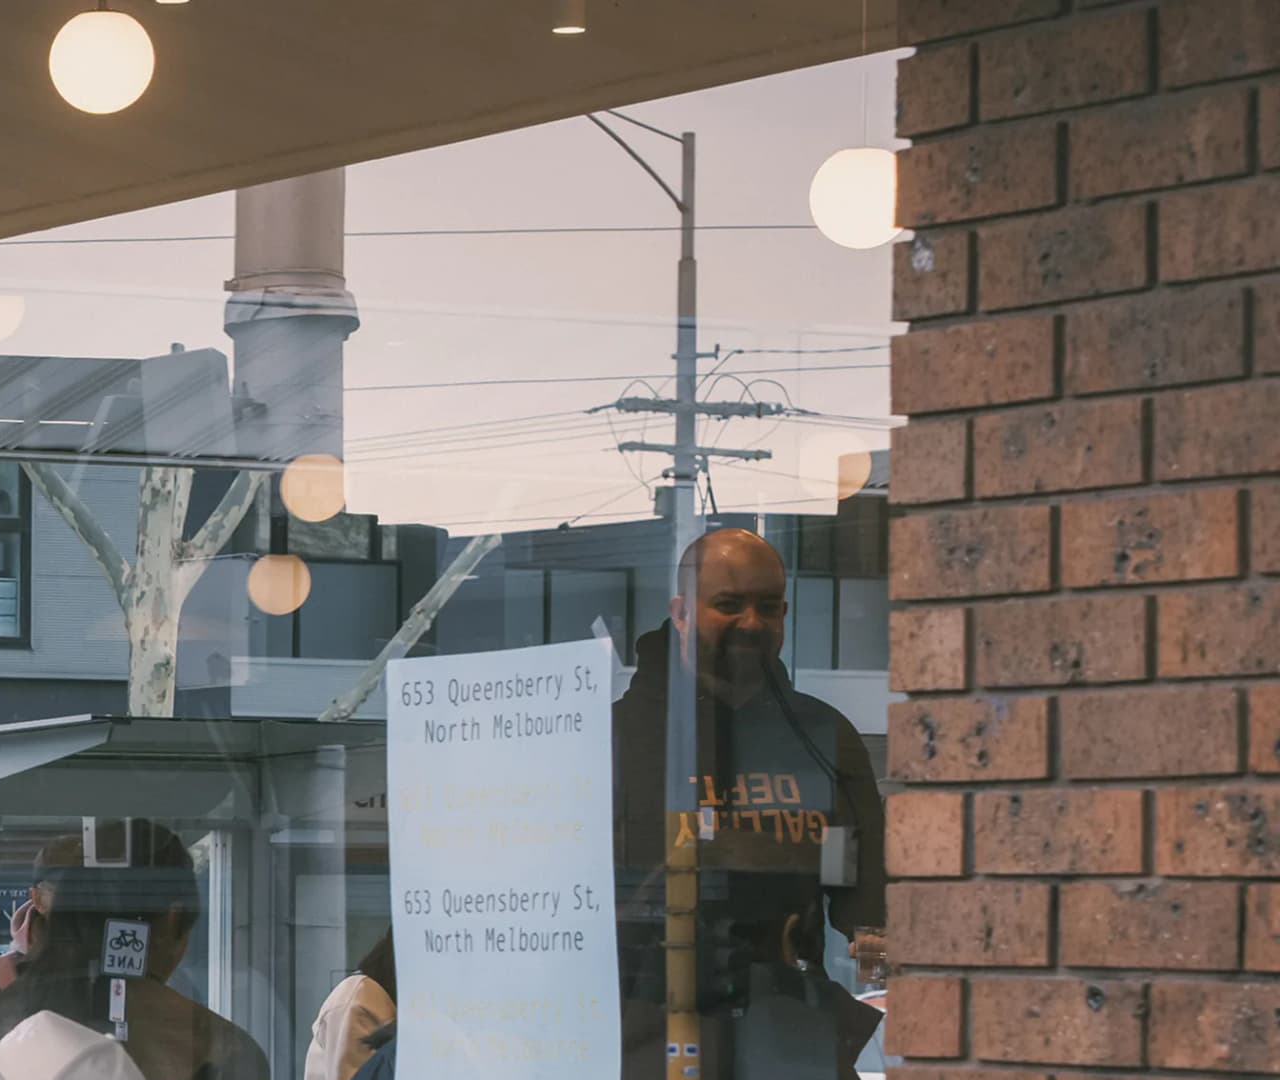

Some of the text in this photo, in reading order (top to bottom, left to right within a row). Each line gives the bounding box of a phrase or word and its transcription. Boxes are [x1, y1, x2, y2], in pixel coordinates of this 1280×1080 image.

[401, 666, 599, 708] 653 Queensberry St,
[424, 711, 584, 745] North Melbourne
[403, 883, 600, 917] 653 Queensberry St,
[424, 926, 585, 954] North Melbourne
